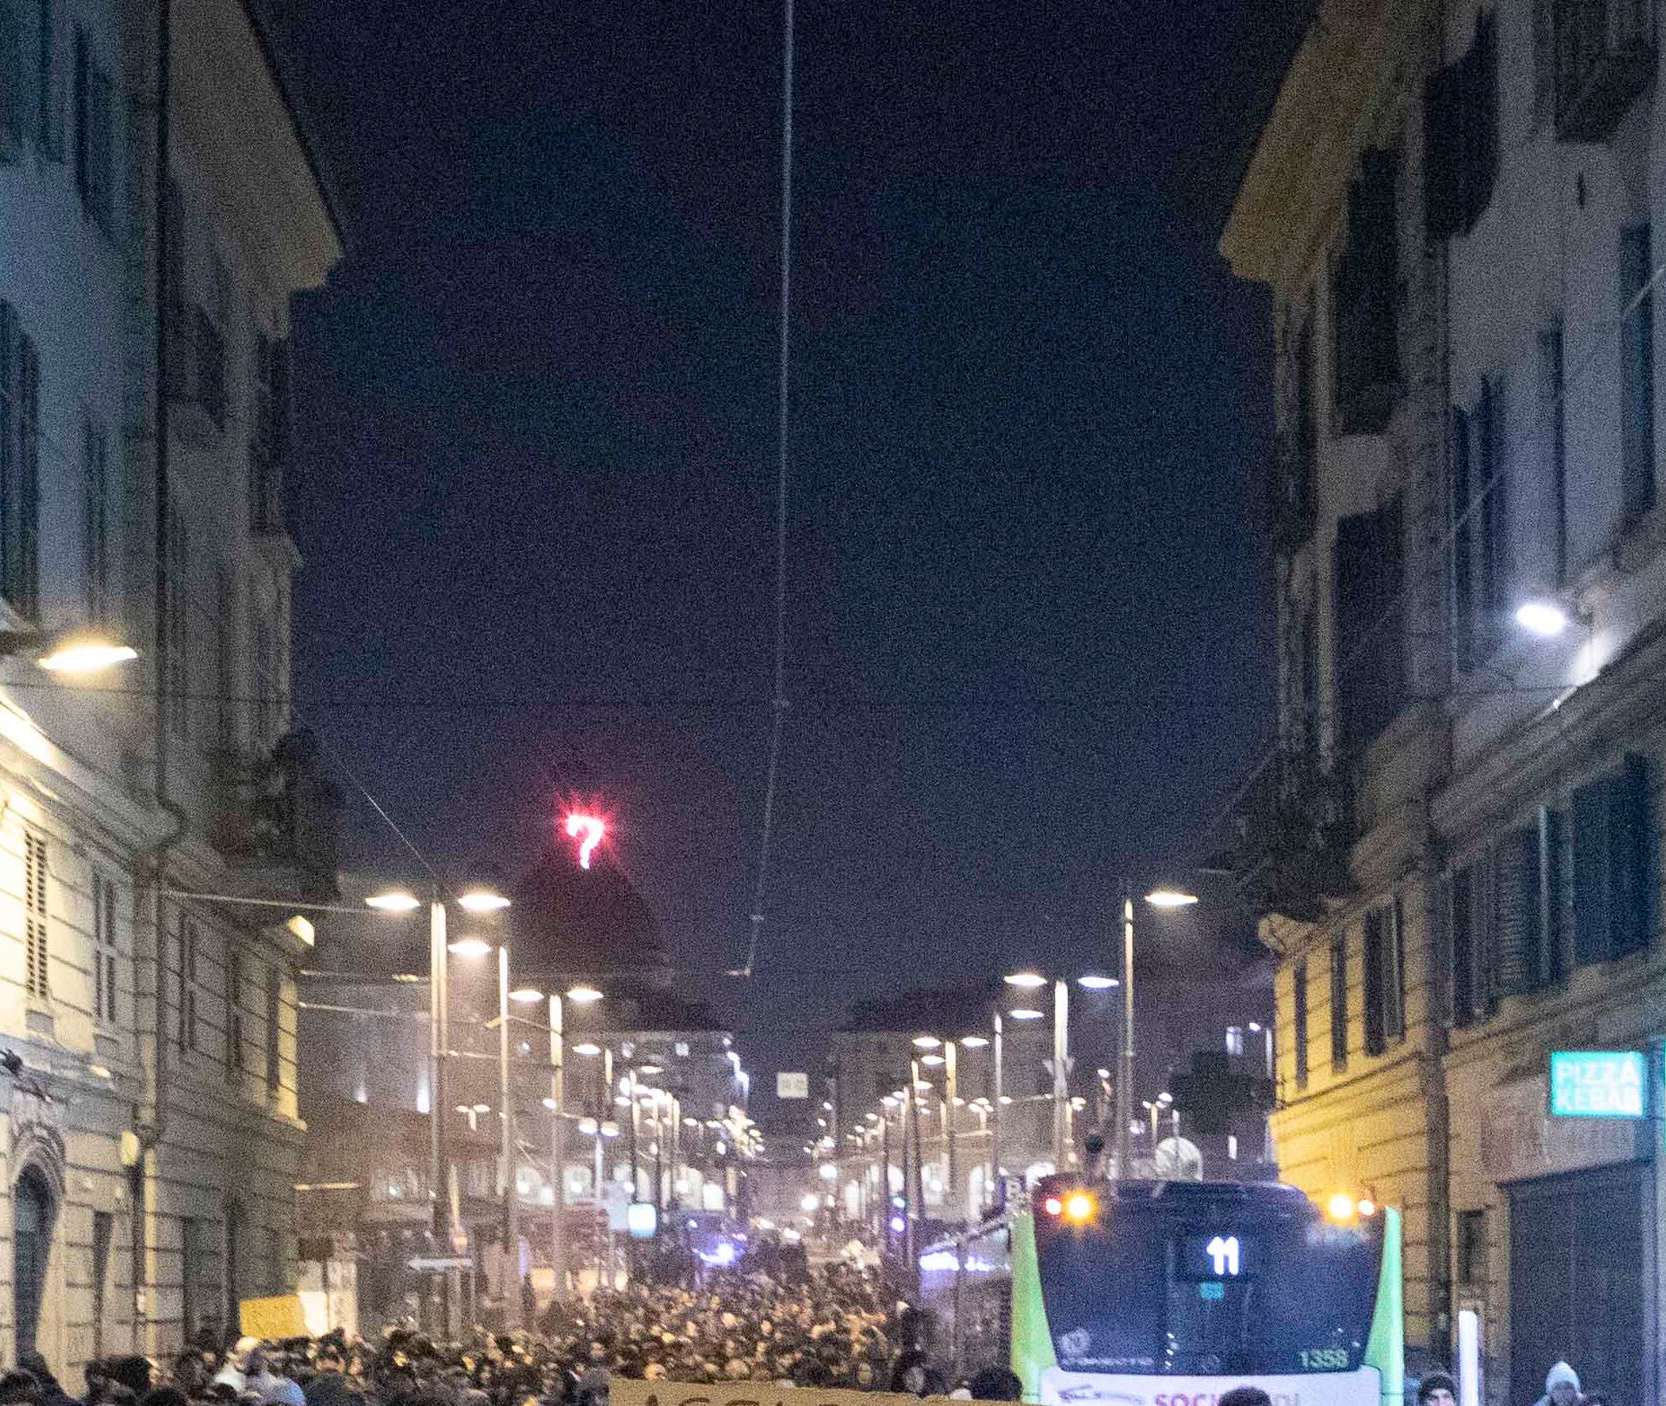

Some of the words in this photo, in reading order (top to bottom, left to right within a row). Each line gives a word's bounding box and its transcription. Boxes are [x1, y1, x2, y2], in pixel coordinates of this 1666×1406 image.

[1556, 1058, 1640, 1086] PIZZA
[1556, 1087, 1642, 1113] KEBAB
[1206, 1235, 1241, 1277] 11
